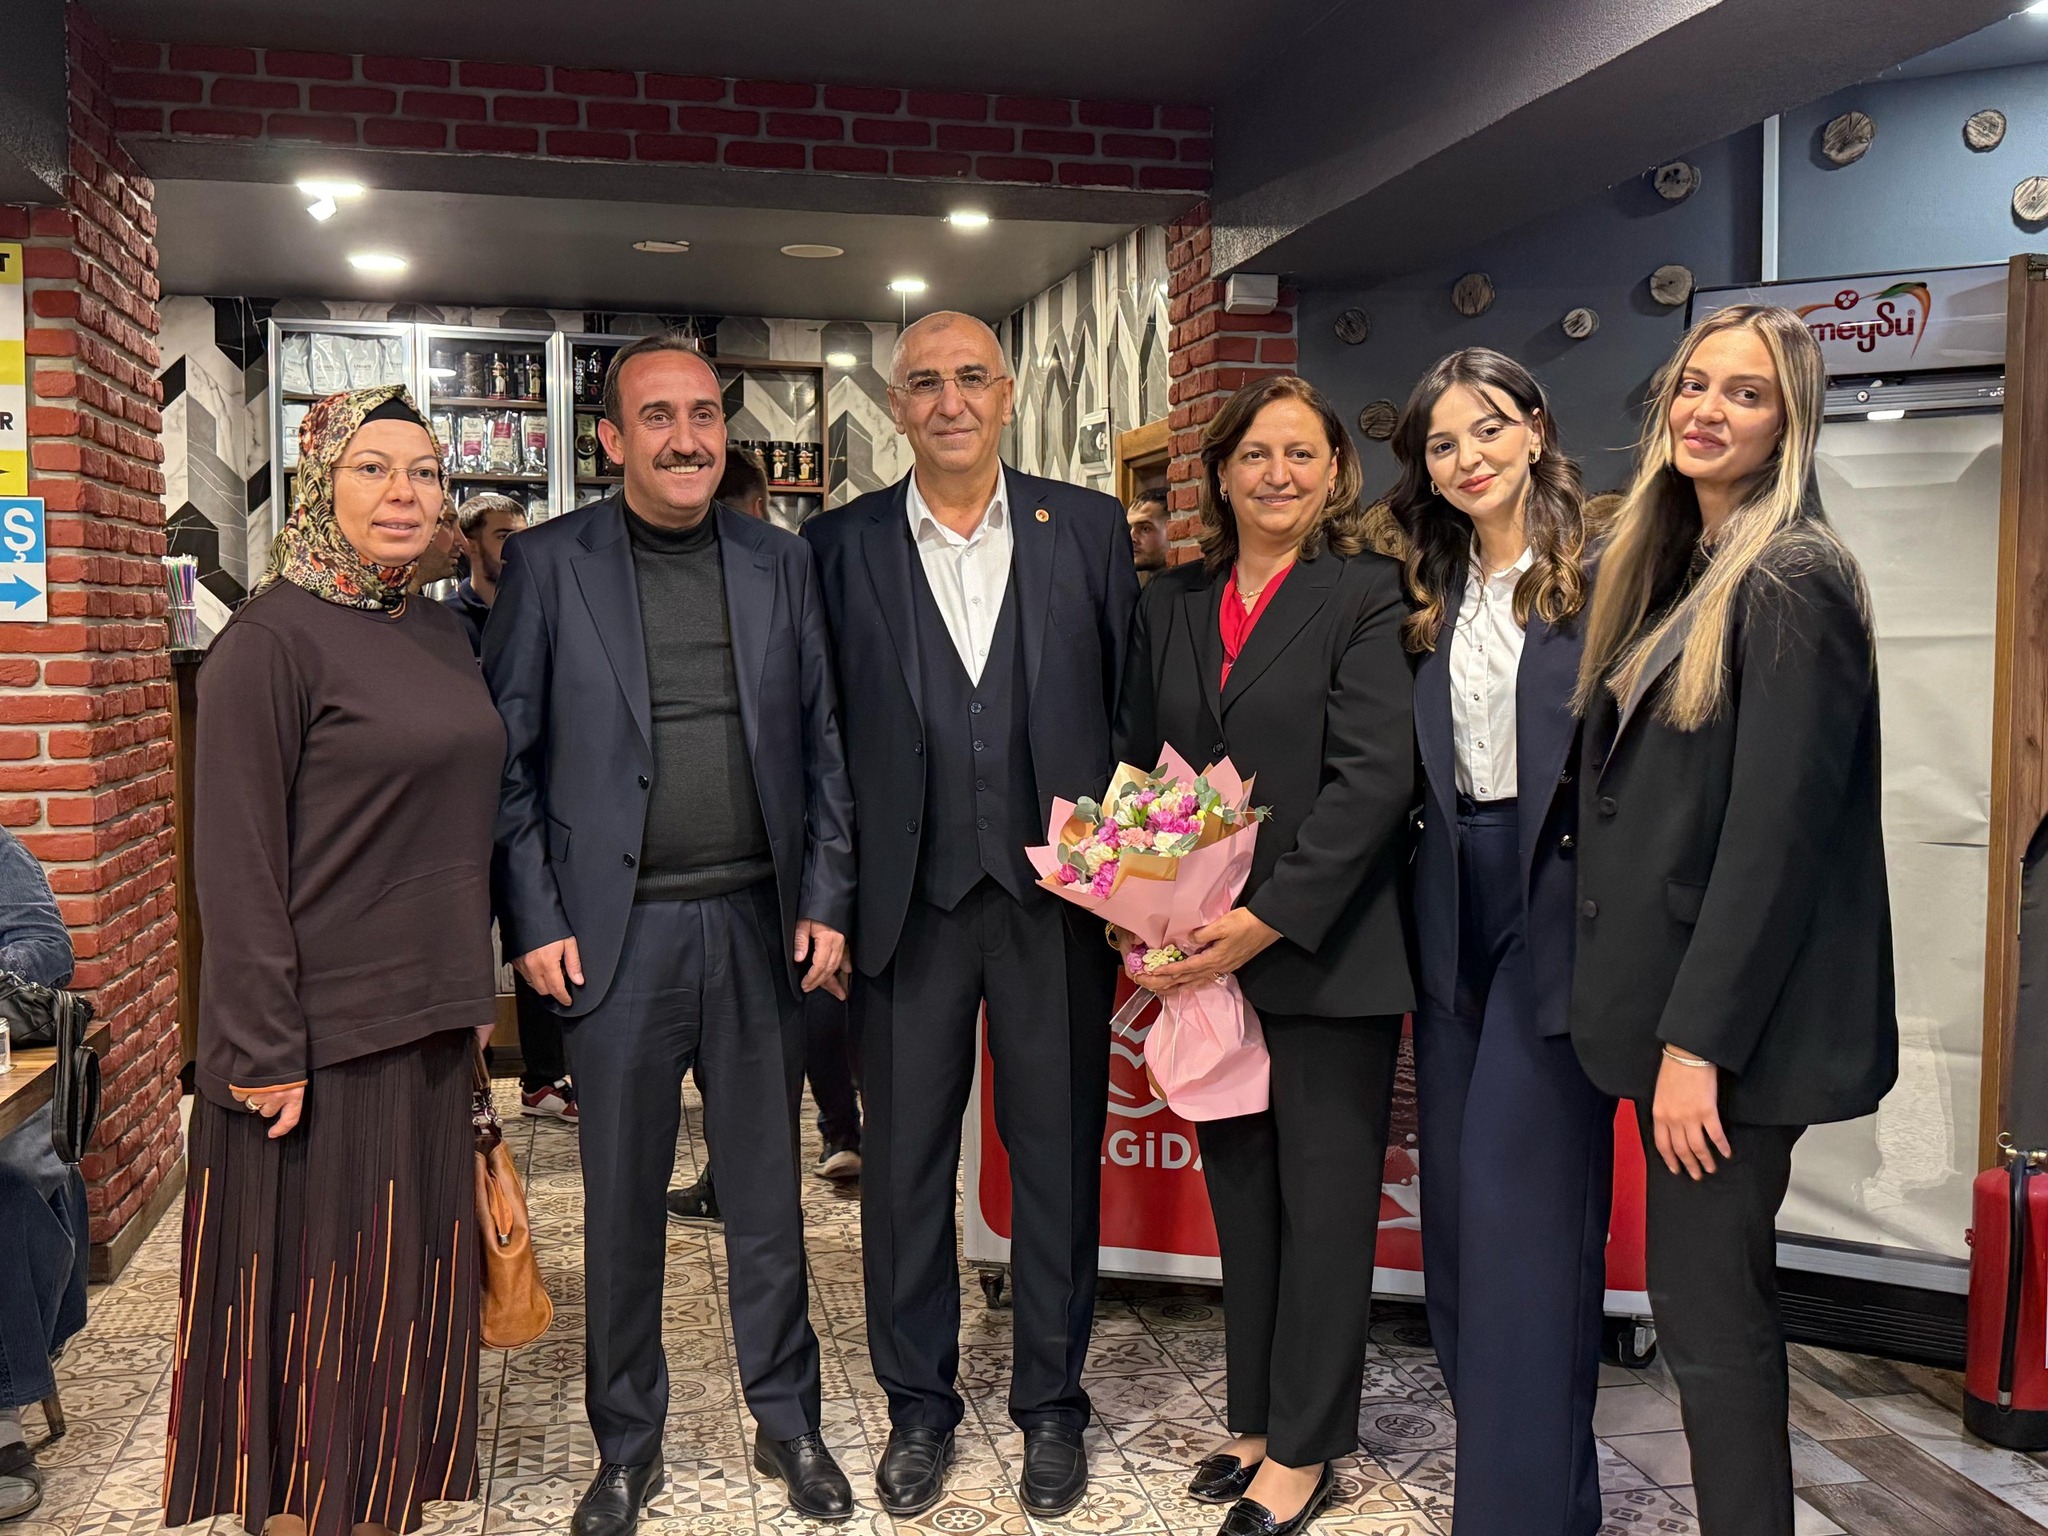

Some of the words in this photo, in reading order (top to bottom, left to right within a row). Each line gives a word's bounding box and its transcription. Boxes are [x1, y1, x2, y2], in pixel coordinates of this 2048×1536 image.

[574, 359, 586, 395] Espresso
[0, 412, 14, 430] R
[3, 507, 37, 562] Ş
